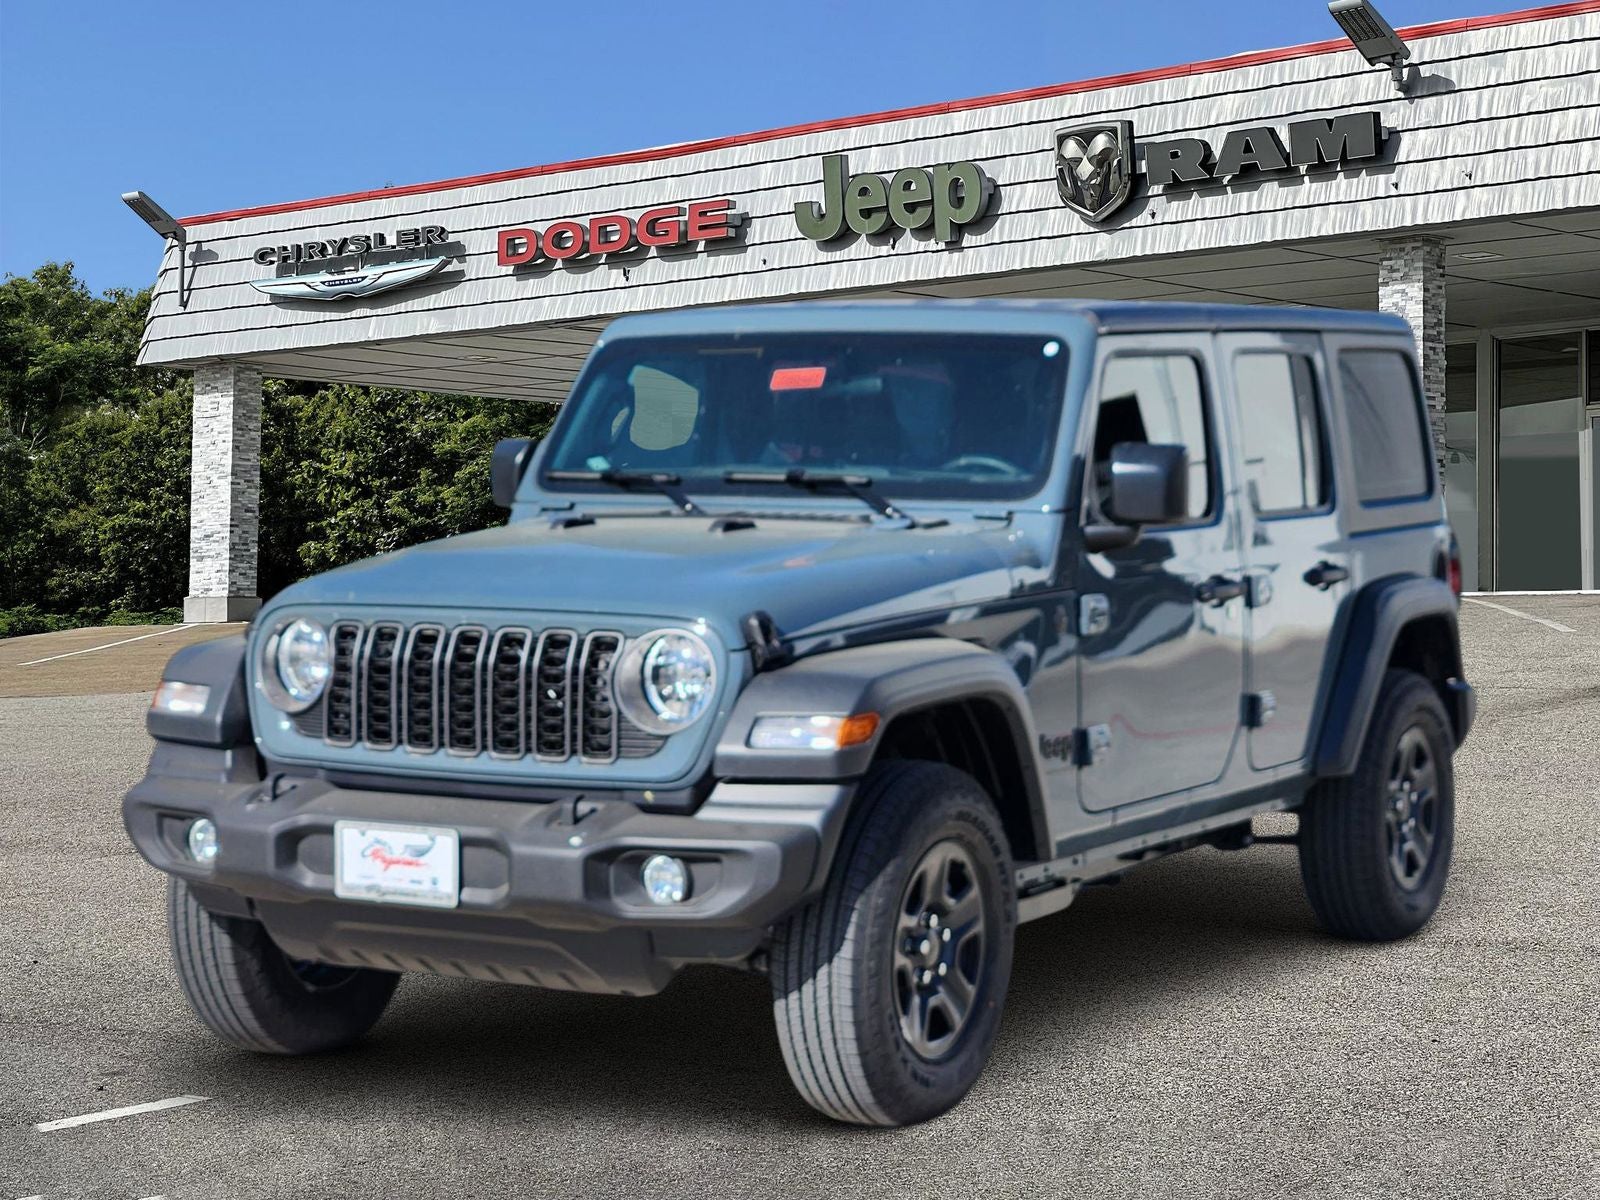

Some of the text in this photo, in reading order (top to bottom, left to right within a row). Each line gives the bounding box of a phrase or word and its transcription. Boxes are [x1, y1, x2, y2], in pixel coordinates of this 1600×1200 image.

[1145, 111, 1386, 186] RAM
[795, 155, 986, 242] Jeep
[253, 225, 448, 266] CHRYSLER
[498, 199, 735, 267] DODGE
[324, 277, 363, 286] CHRYSLER
